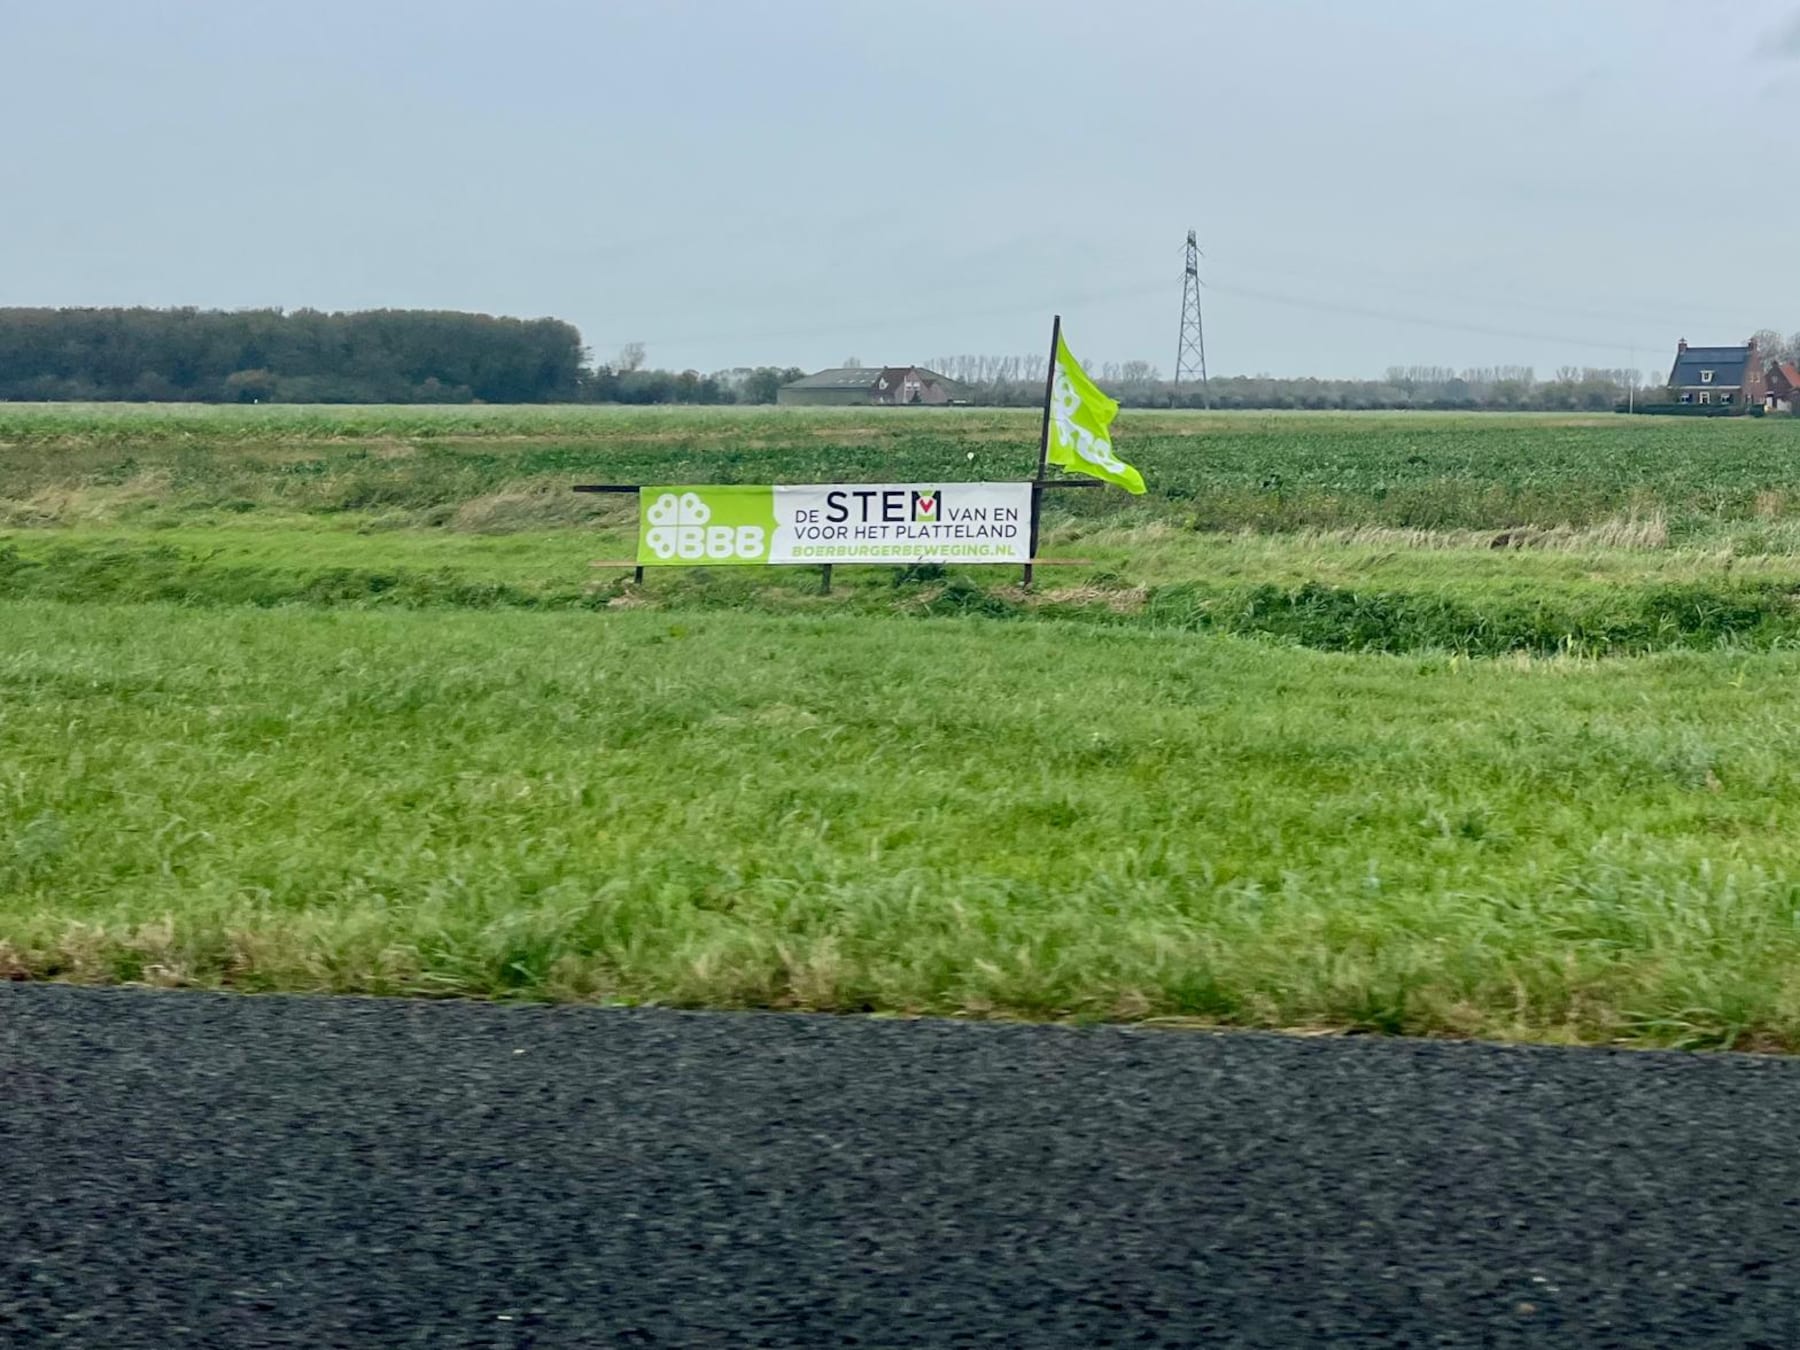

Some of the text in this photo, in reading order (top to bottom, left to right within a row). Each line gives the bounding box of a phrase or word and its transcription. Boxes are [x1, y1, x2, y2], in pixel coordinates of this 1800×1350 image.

[795, 490, 1018, 523] DE STEM VAN EN
[677, 526, 765, 559] BBB
[794, 524, 1018, 539] VOOR HET PLATTELAND
[791, 544, 1017, 557] BOERBURGERBEWEGING.NL
